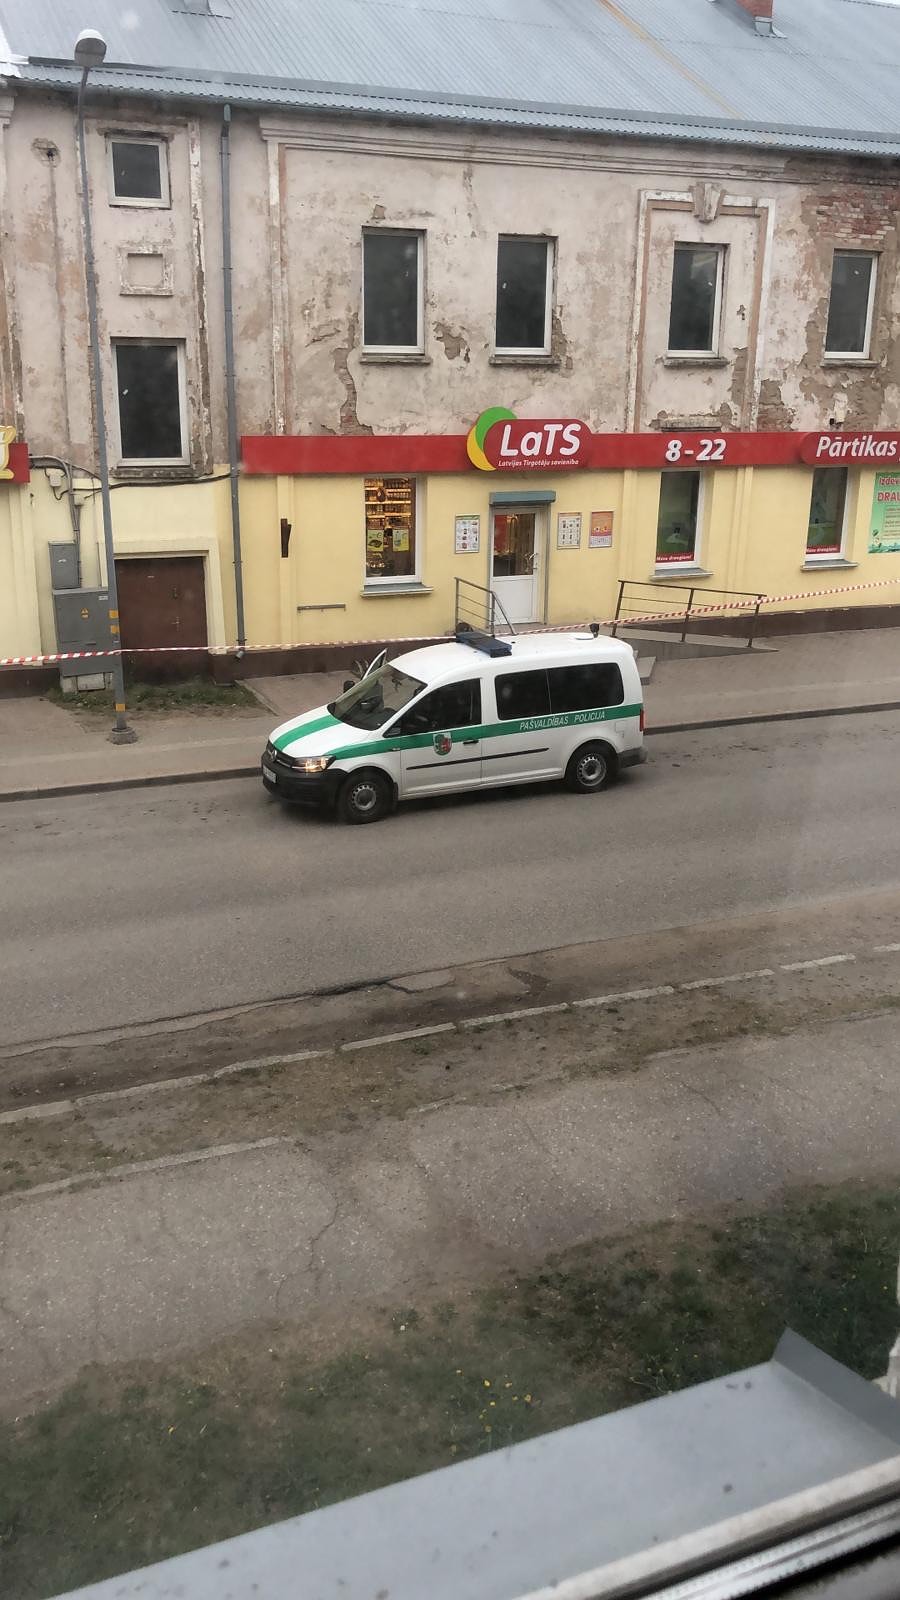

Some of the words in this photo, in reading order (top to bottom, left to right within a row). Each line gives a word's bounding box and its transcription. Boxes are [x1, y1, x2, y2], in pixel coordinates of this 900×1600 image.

[500, 423, 581, 456] LaTS
[816, 434, 898, 457] Pārtikas
[498, 459, 523, 468] Latvijas
[520, 715, 569, 731] PAŠVALDĪBAS
[574, 711, 606, 722] POLICIJA
